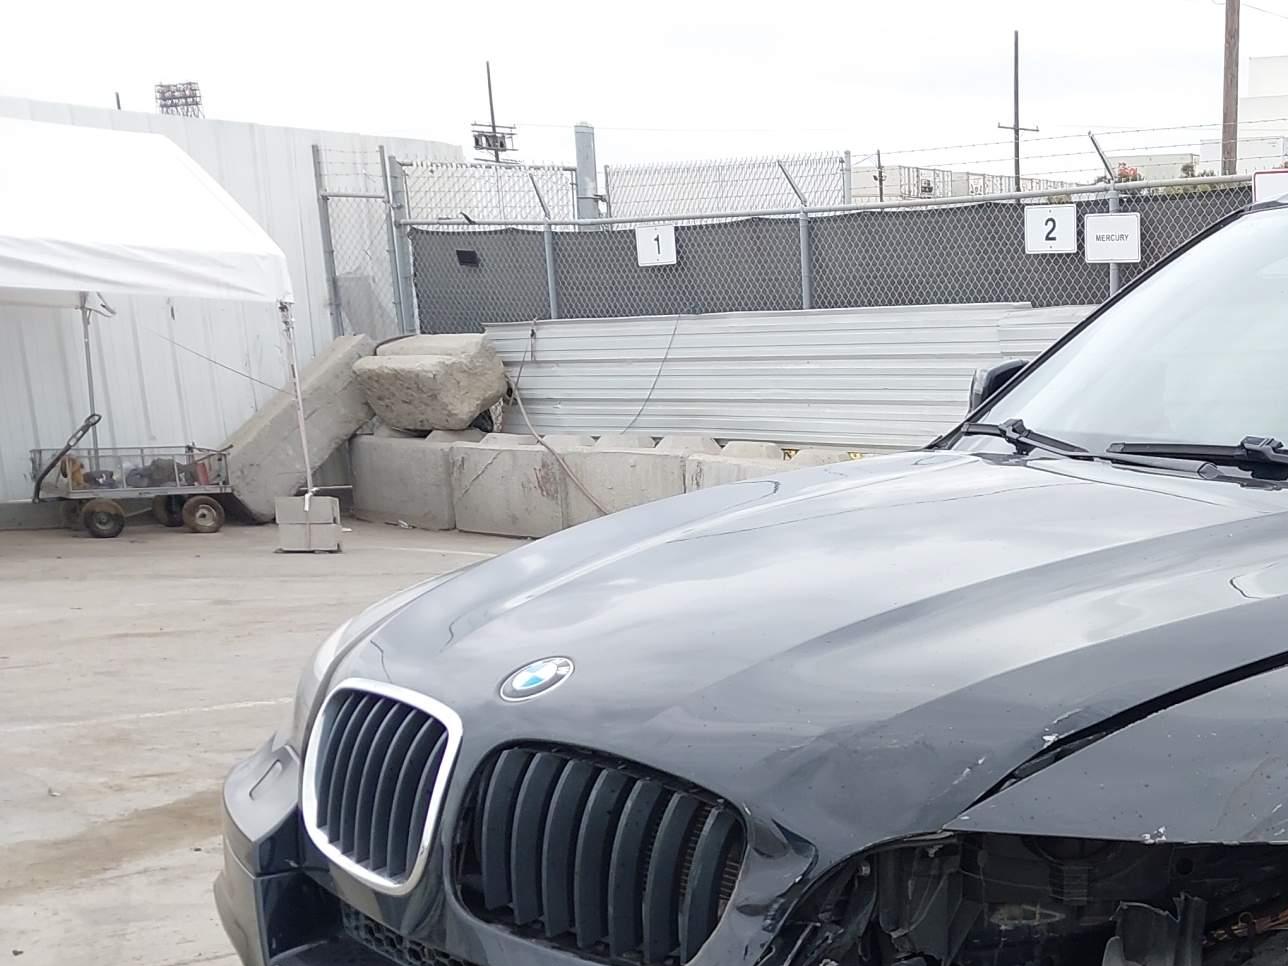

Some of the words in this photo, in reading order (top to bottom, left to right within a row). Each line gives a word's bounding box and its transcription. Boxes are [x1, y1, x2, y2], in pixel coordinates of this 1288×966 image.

[1044, 217, 1057, 242] 2
[1095, 233, 1129, 242] MERCURY
[653, 234, 661, 255] 1
